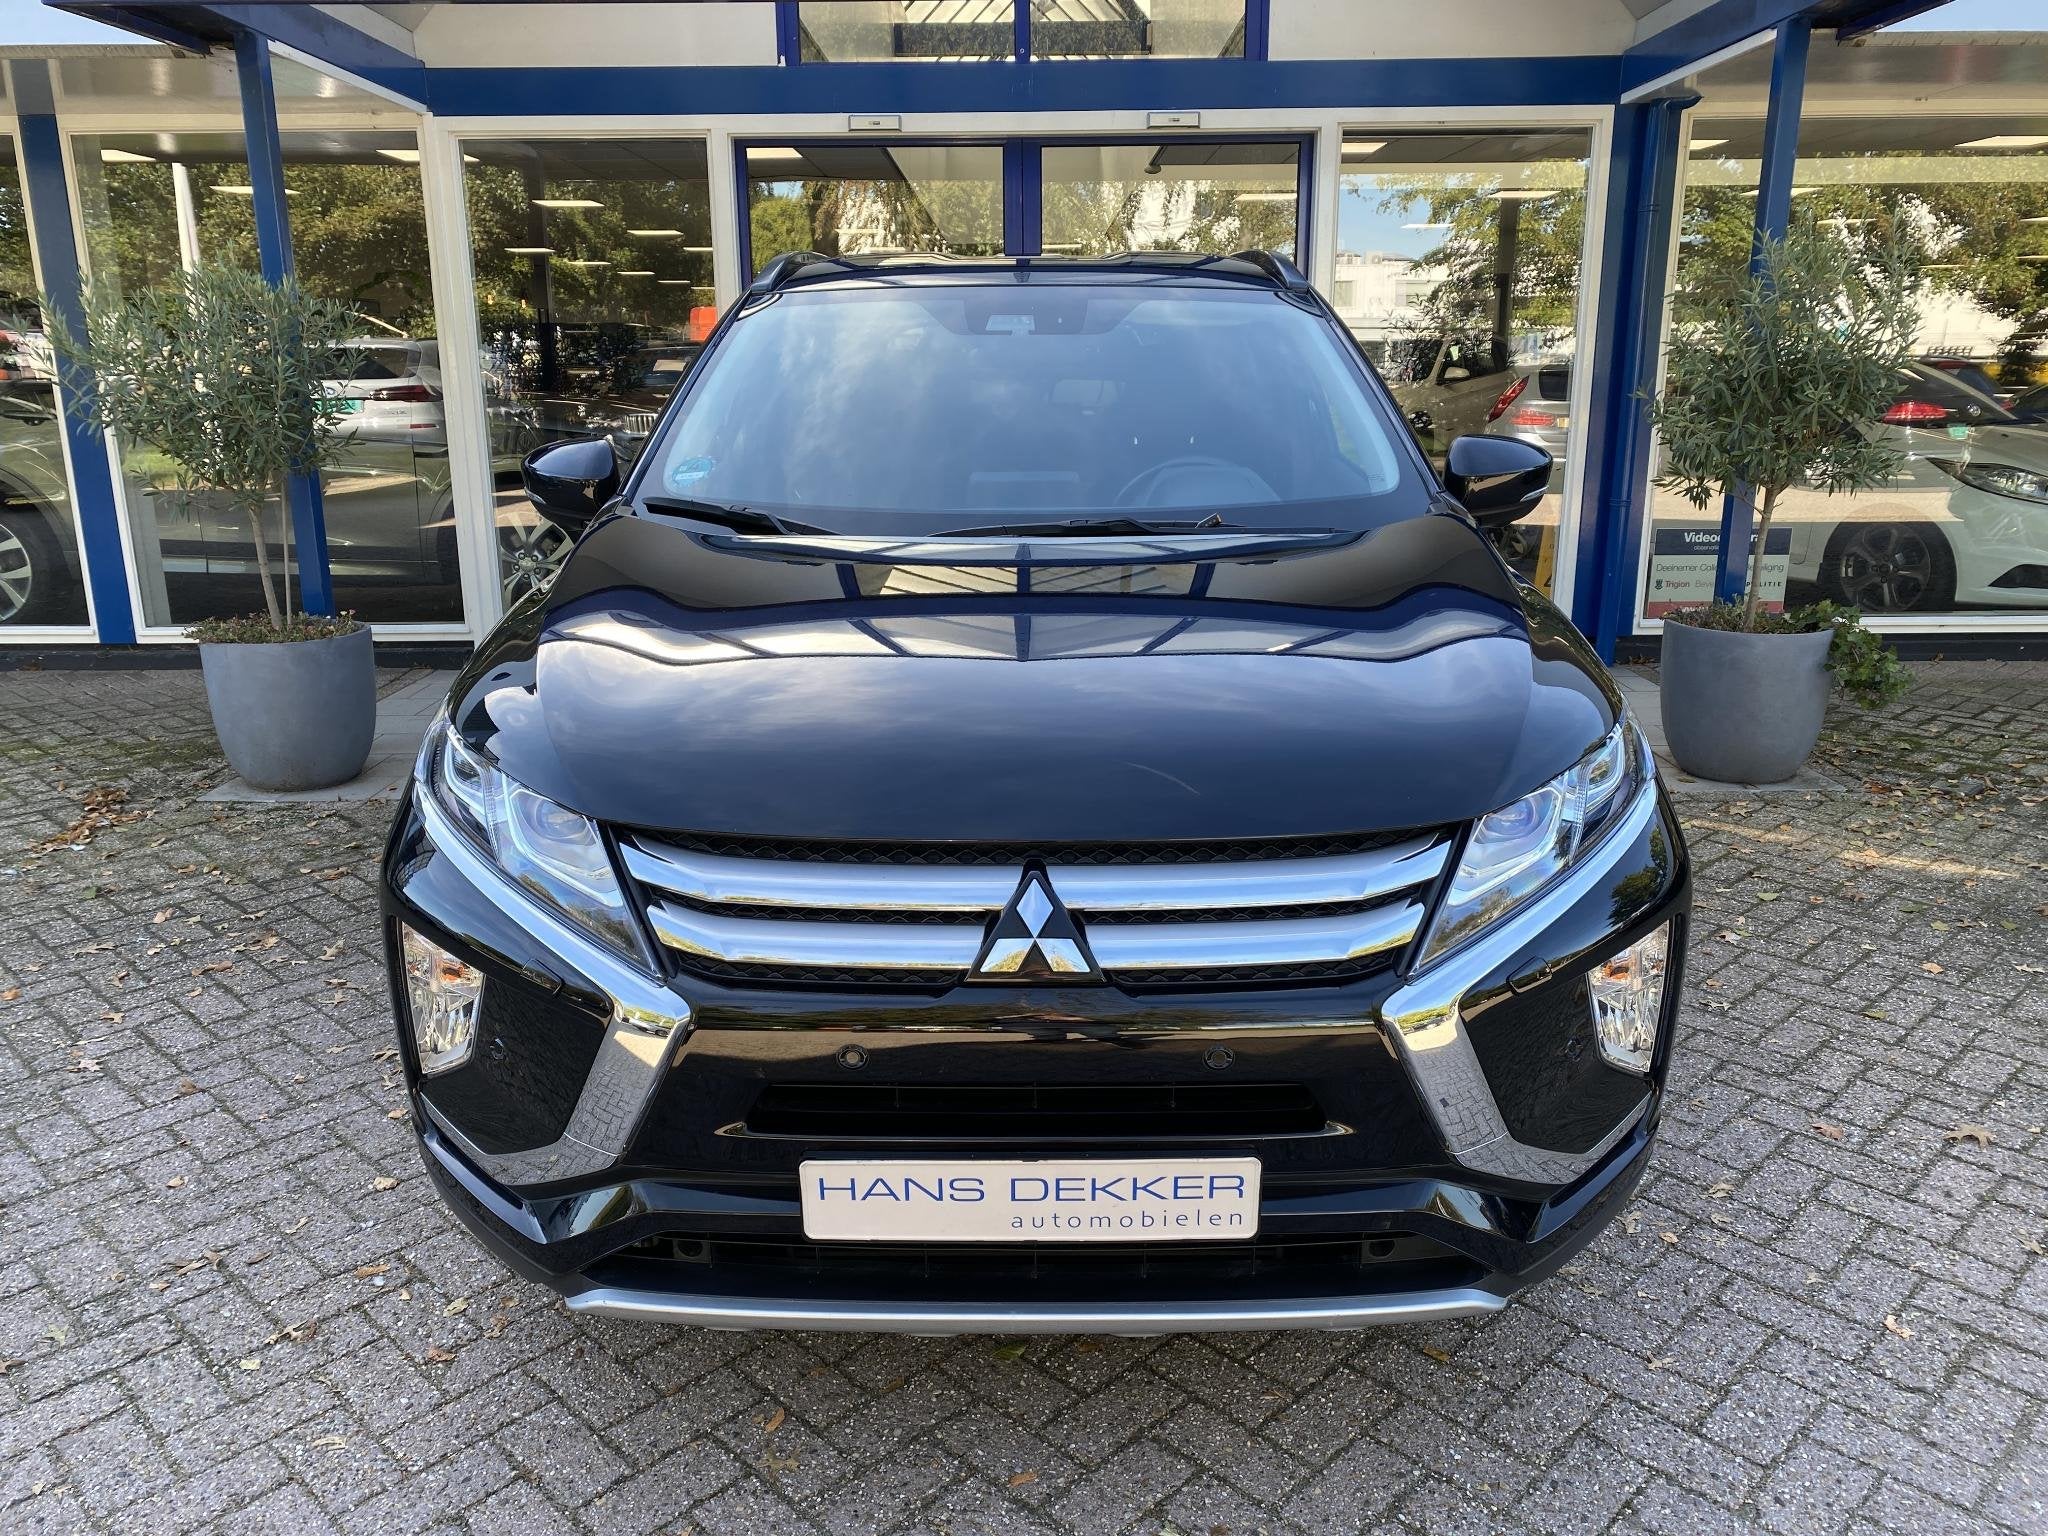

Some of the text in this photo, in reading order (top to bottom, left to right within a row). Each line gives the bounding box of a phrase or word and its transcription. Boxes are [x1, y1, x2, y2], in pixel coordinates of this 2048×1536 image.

[1665, 580, 1690, 590] Trigion
[818, 1175, 1245, 1202] HANS DEKKER
[1011, 1208, 1243, 1229] automobielen
